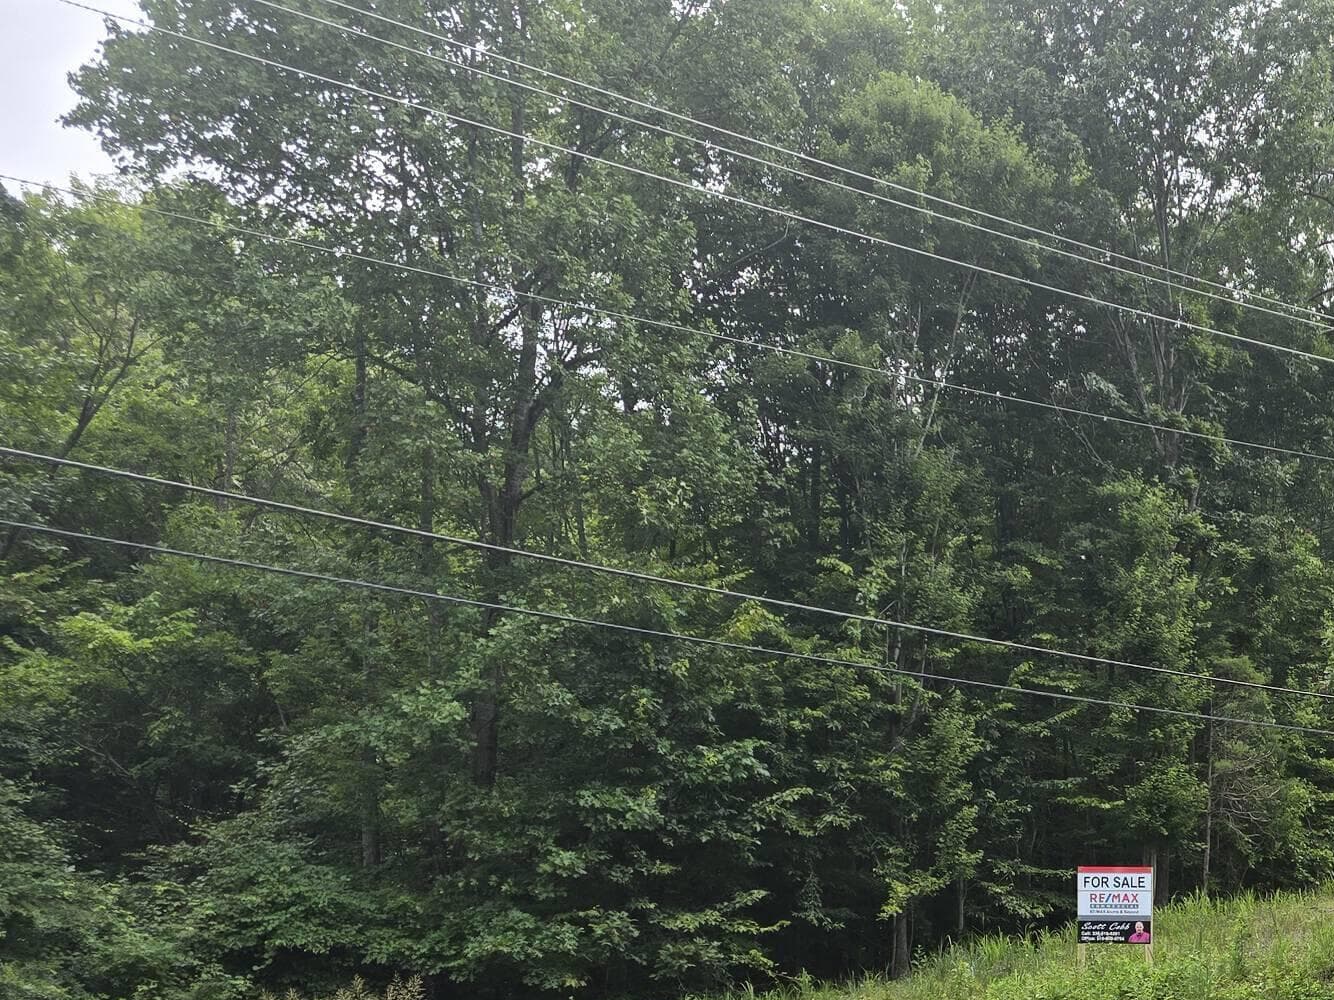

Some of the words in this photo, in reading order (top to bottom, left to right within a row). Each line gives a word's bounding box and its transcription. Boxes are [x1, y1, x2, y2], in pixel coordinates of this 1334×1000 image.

[1083, 876, 1109, 888] FOR
[1113, 876, 1146, 888] SALE
[1089, 893, 1139, 903] RE/MAX
[1081, 922, 1107, 930] Scott
